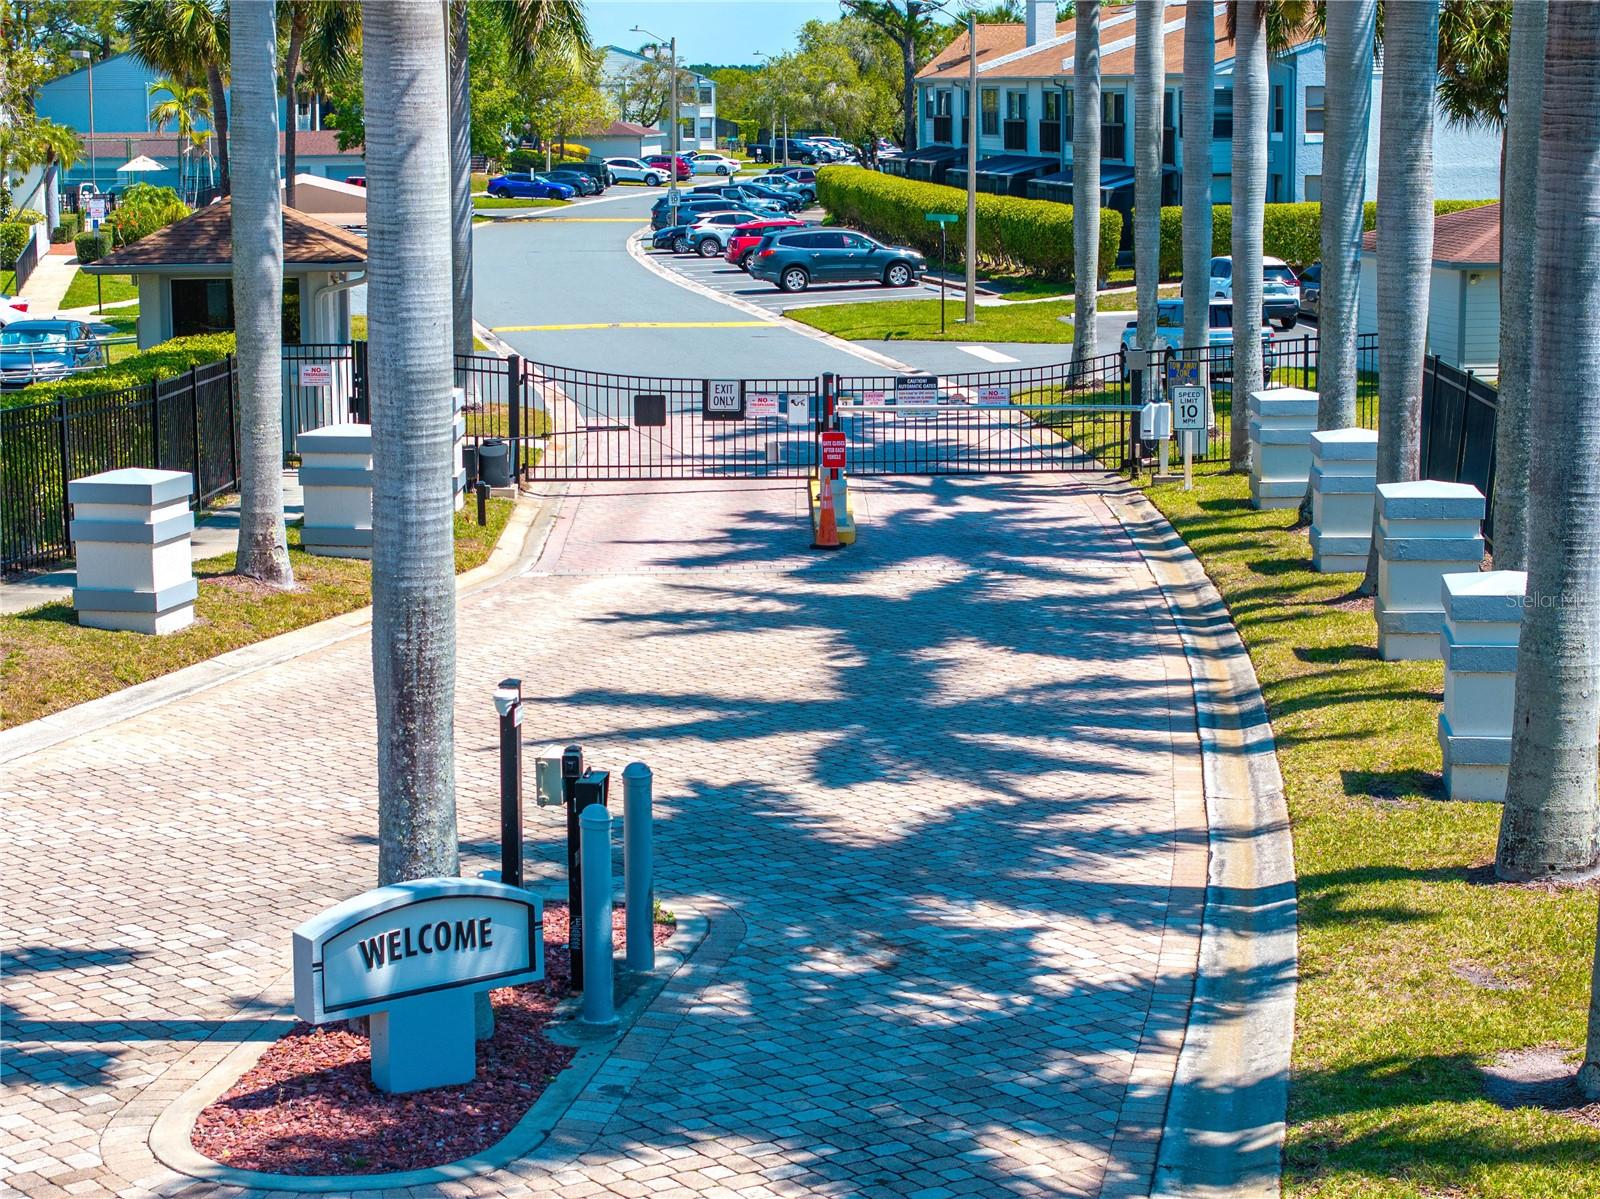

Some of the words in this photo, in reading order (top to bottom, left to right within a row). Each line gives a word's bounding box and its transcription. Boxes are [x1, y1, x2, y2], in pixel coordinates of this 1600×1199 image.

[715, 384, 733, 394] EXIT
[713, 396, 735, 405] ONLY
[1181, 405, 1198, 418] 10
[359, 917, 493, 970] WELCOME
